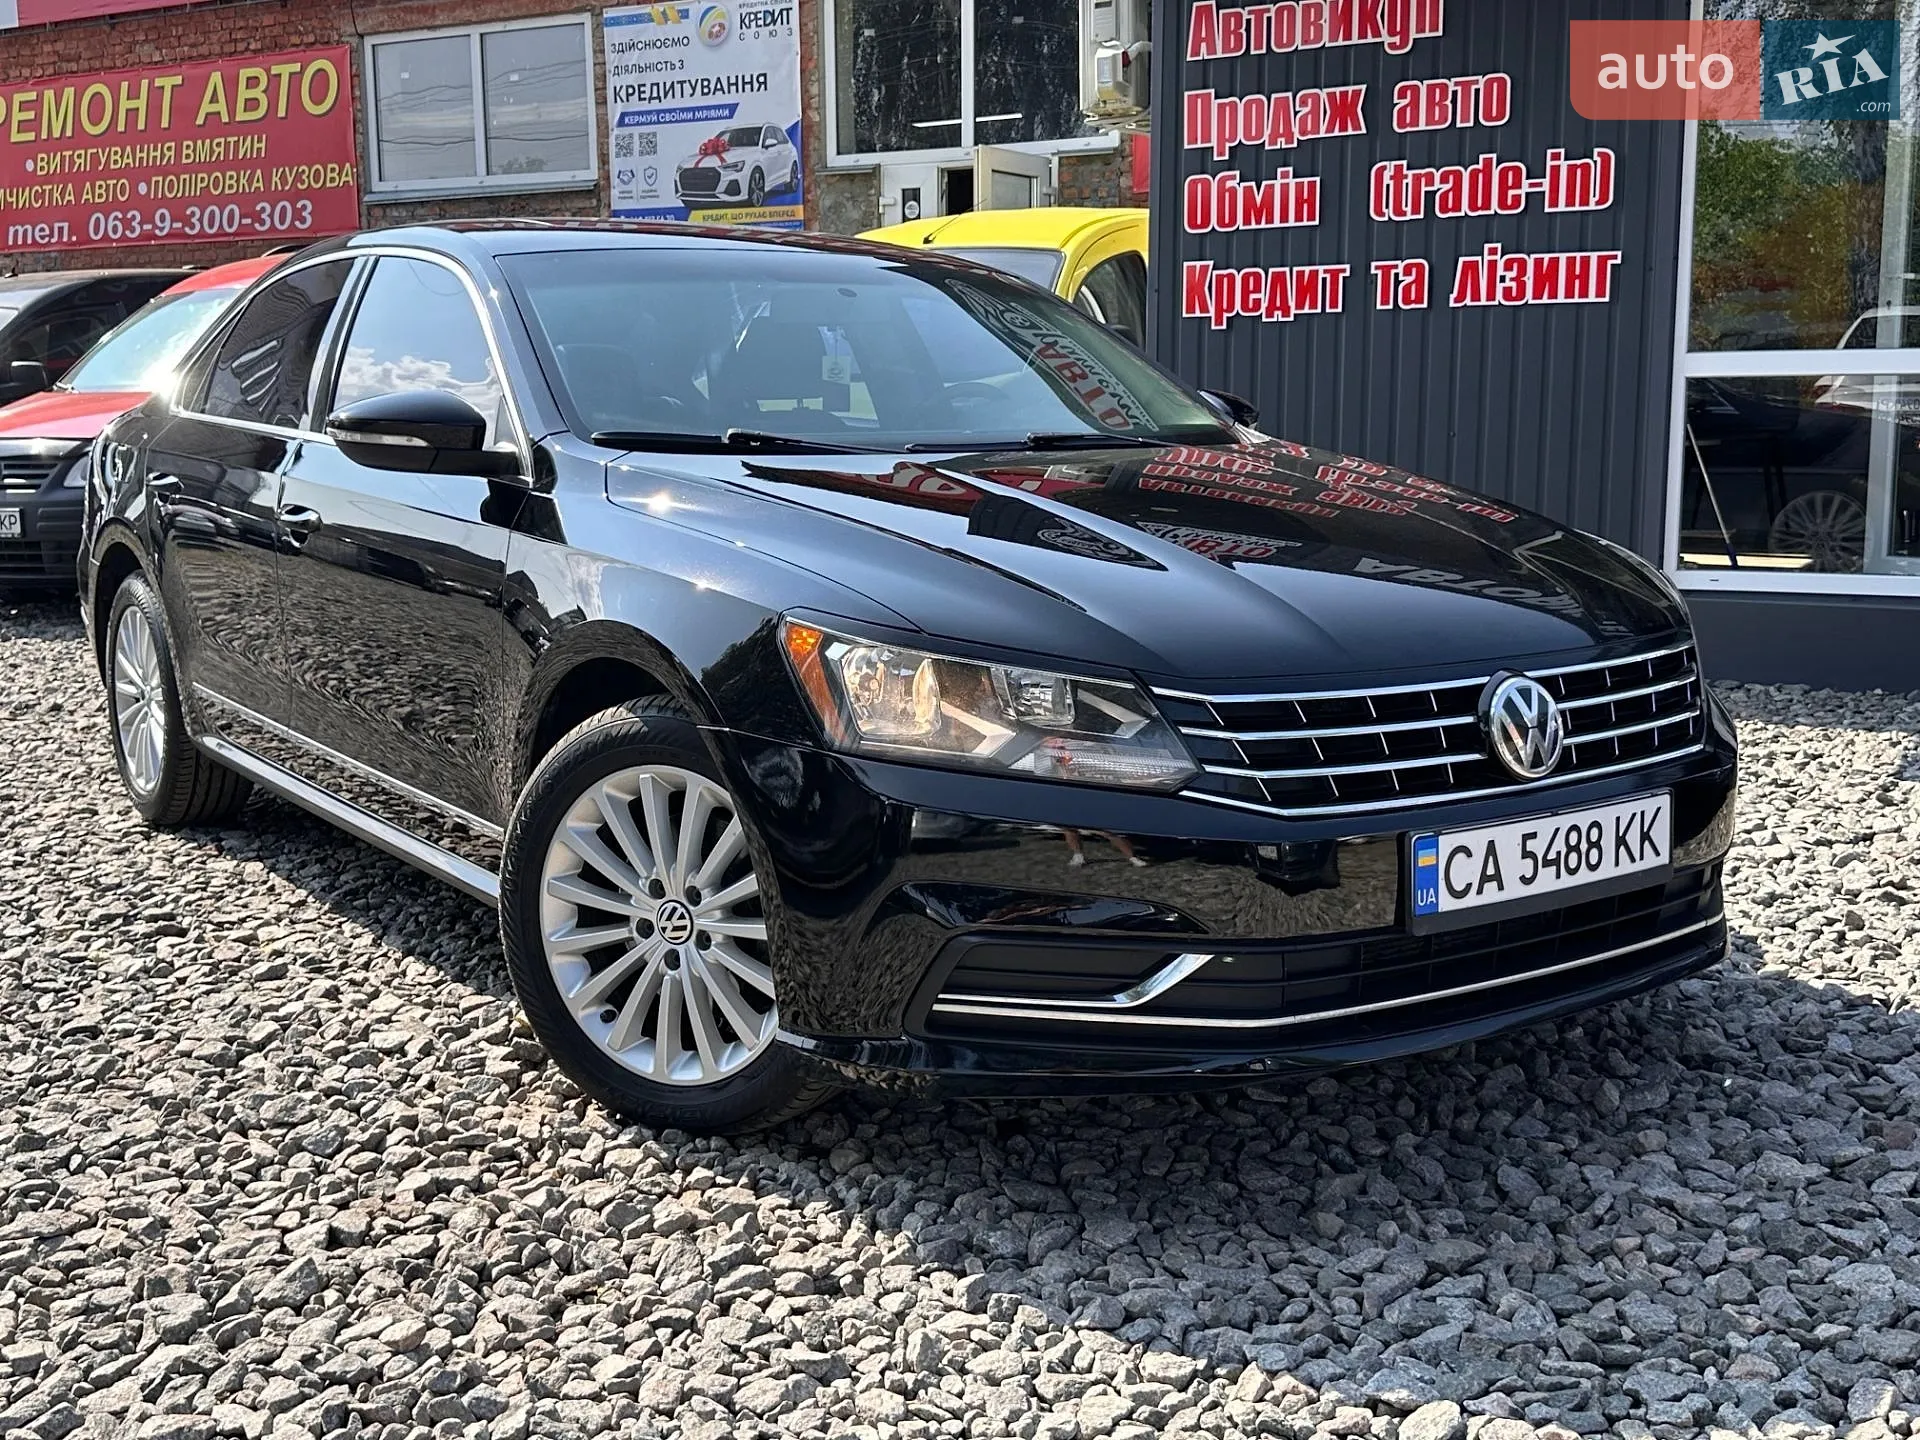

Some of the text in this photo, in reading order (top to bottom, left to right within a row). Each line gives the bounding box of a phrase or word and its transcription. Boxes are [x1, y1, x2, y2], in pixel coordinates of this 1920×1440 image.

[611, 36, 690, 55] ЗДІЙСНЮЄМО
[1186, 0, 1444, 61] Автовикуп
[612, 59, 685, 77] ДІЯЛЬНІСТЬ З
[613, 73, 768, 104] КРЕДИТУВАННЯ
[0, 59, 338, 143] ЕМОНТ АВТО
[625, 108, 729, 124] КЕРМУЙ СВОЇМИ МРІЯМИ
[1184, 73, 1511, 160] Продаж авто
[37, 134, 266, 176] ВИТЯГУВАННЯ ВМЯТИН
[81, 179, 130, 204] АВТО
[151, 168, 264, 199] ПОЛІРОВКА
[271, 163, 353, 192] КУЗОВА
[1184, 148, 1615, 234] Обмін (trade-in)
[8, 200, 313, 246] тел. 063-9-300-303
[1182, 243, 1622, 330] Кредит та лізинг
[1444, 806, 1662, 899] CA 5488 KK
[1418, 887, 1437, 906] UA
